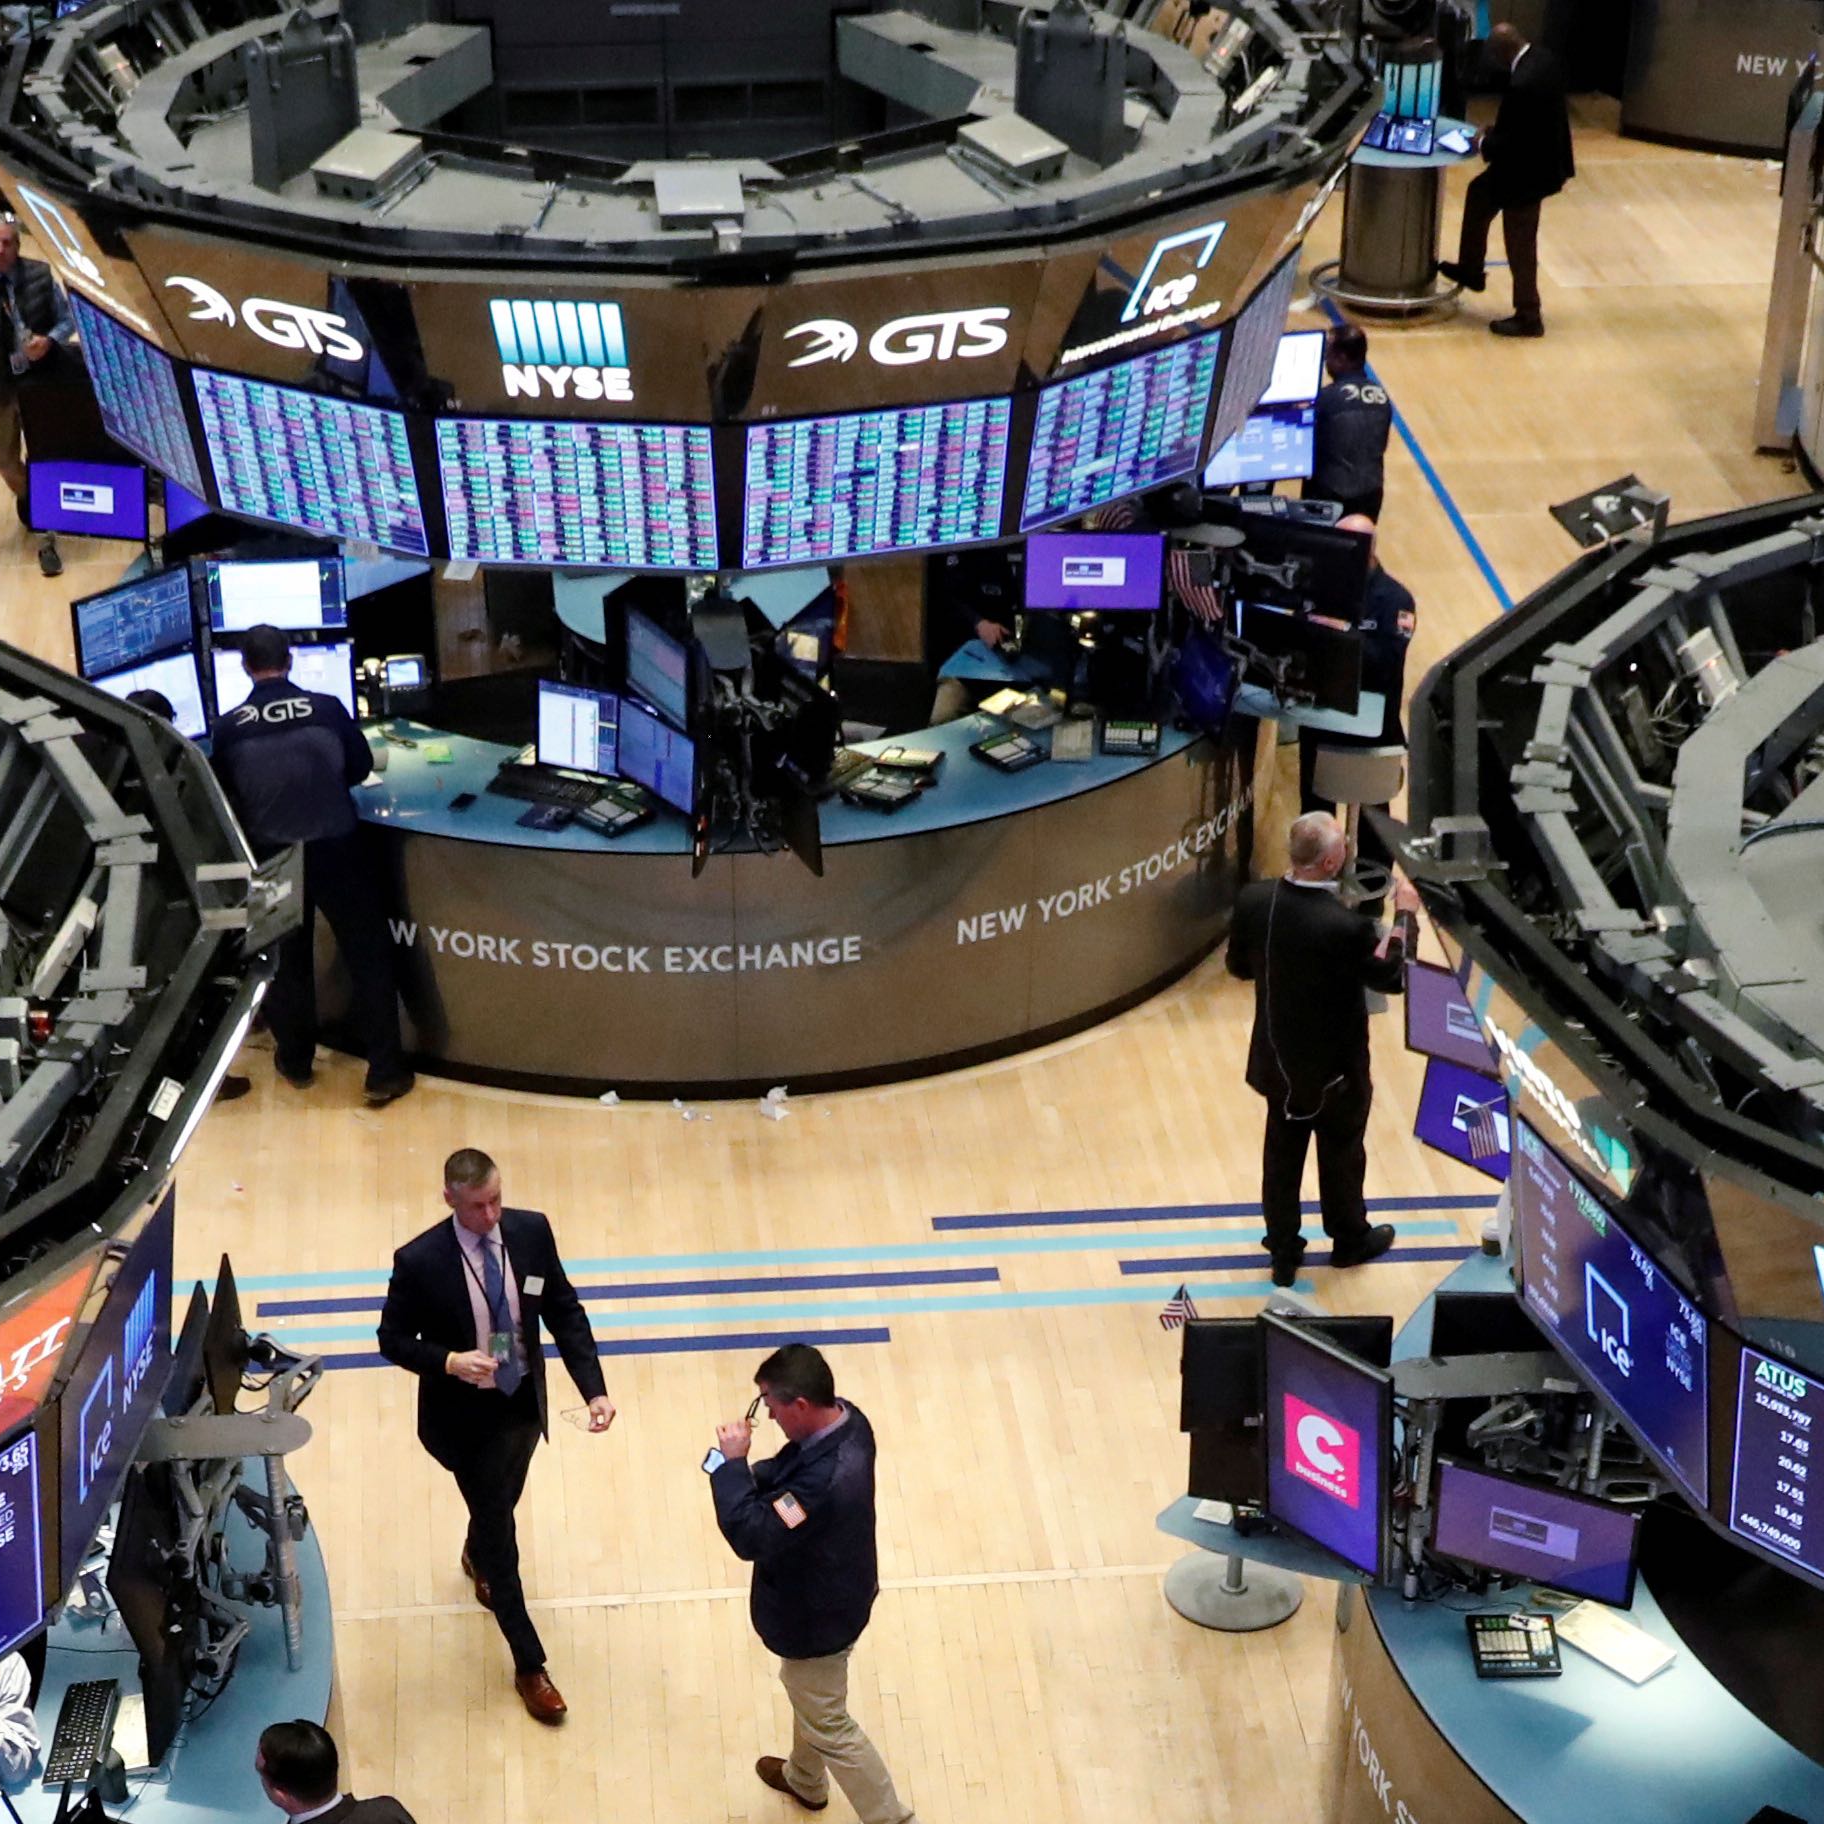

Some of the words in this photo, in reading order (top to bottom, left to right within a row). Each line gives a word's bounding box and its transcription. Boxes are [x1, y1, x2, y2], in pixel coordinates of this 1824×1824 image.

[1736, 54, 1788, 77] NEW
[241, 298, 364, 361] GTS
[869, 306, 1010, 365] GTS
[502, 365, 635, 401] NYSE
[262, 697, 313, 723] GTS
[956, 904, 1027, 945] NEW
[1037, 875, 1113, 923] YORK
[1118, 835, 1191, 895] STOCK
[429, 926, 522, 966] YORK
[532, 942, 650, 973] STOCK
[664, 935, 862, 973] EXCHANGE
[122, 1331, 155, 1415] NYSE
[1754, 1360, 1808, 1398] ATUS
[1295, 1460, 1348, 1499] business
[1351, 1705, 1394, 1815] YORK
